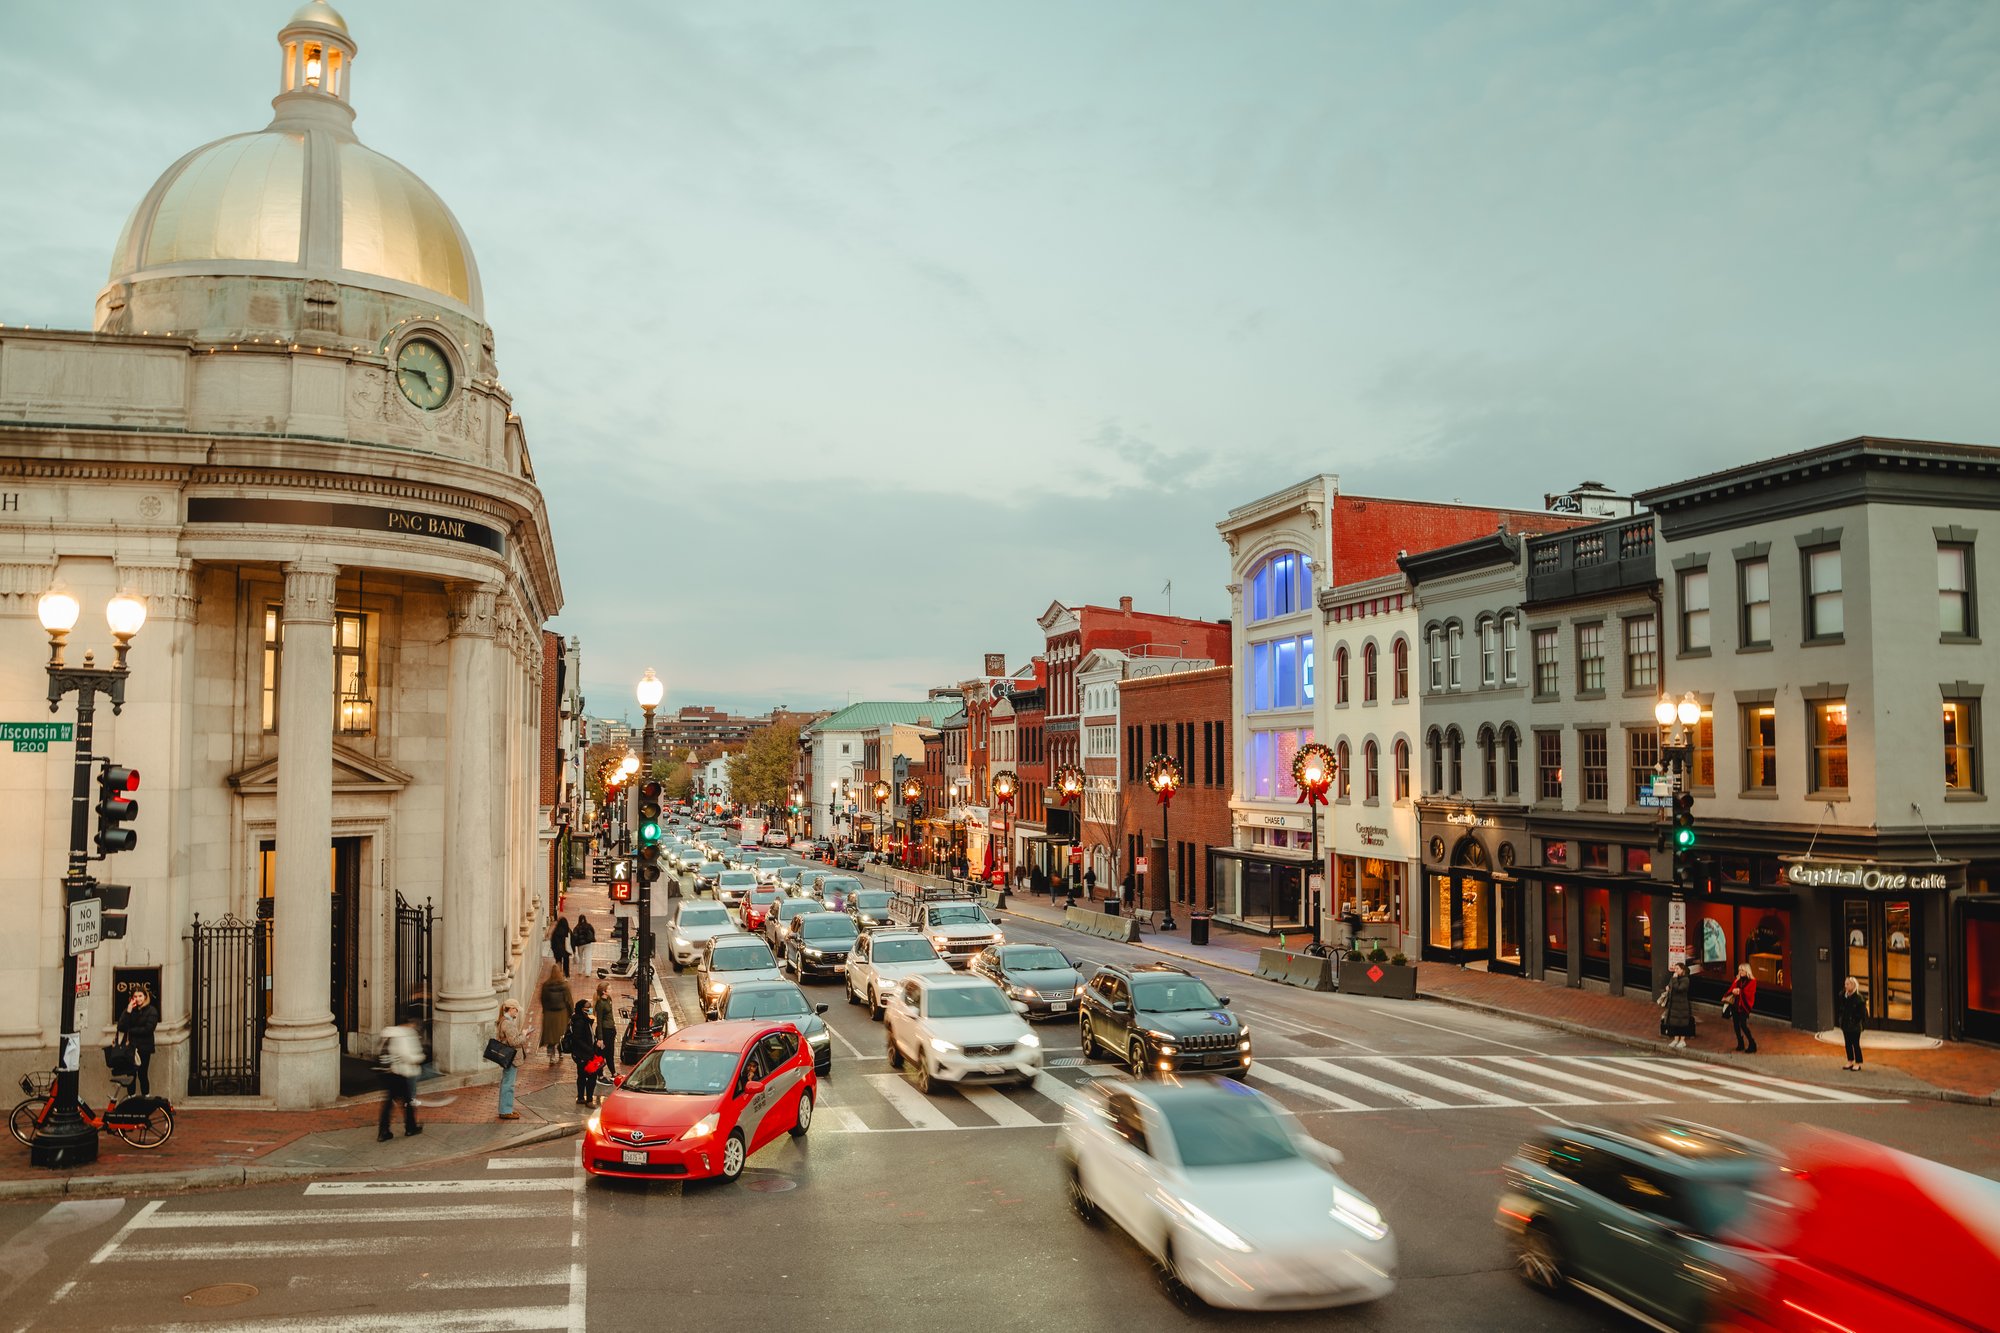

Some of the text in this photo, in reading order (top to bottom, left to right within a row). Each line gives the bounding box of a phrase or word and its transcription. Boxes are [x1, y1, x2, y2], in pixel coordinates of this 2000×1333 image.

[387, 512, 466, 538] PNC BANK
[16, 742, 45, 752] 1200
[1264, 816, 1280, 825] CHASE
[616, 884, 628, 898] 12
[80, 908, 92, 919] NO
[76, 921, 96, 933] TURN
[72, 937, 82, 947] ON
[85, 933, 98, 943] RED
